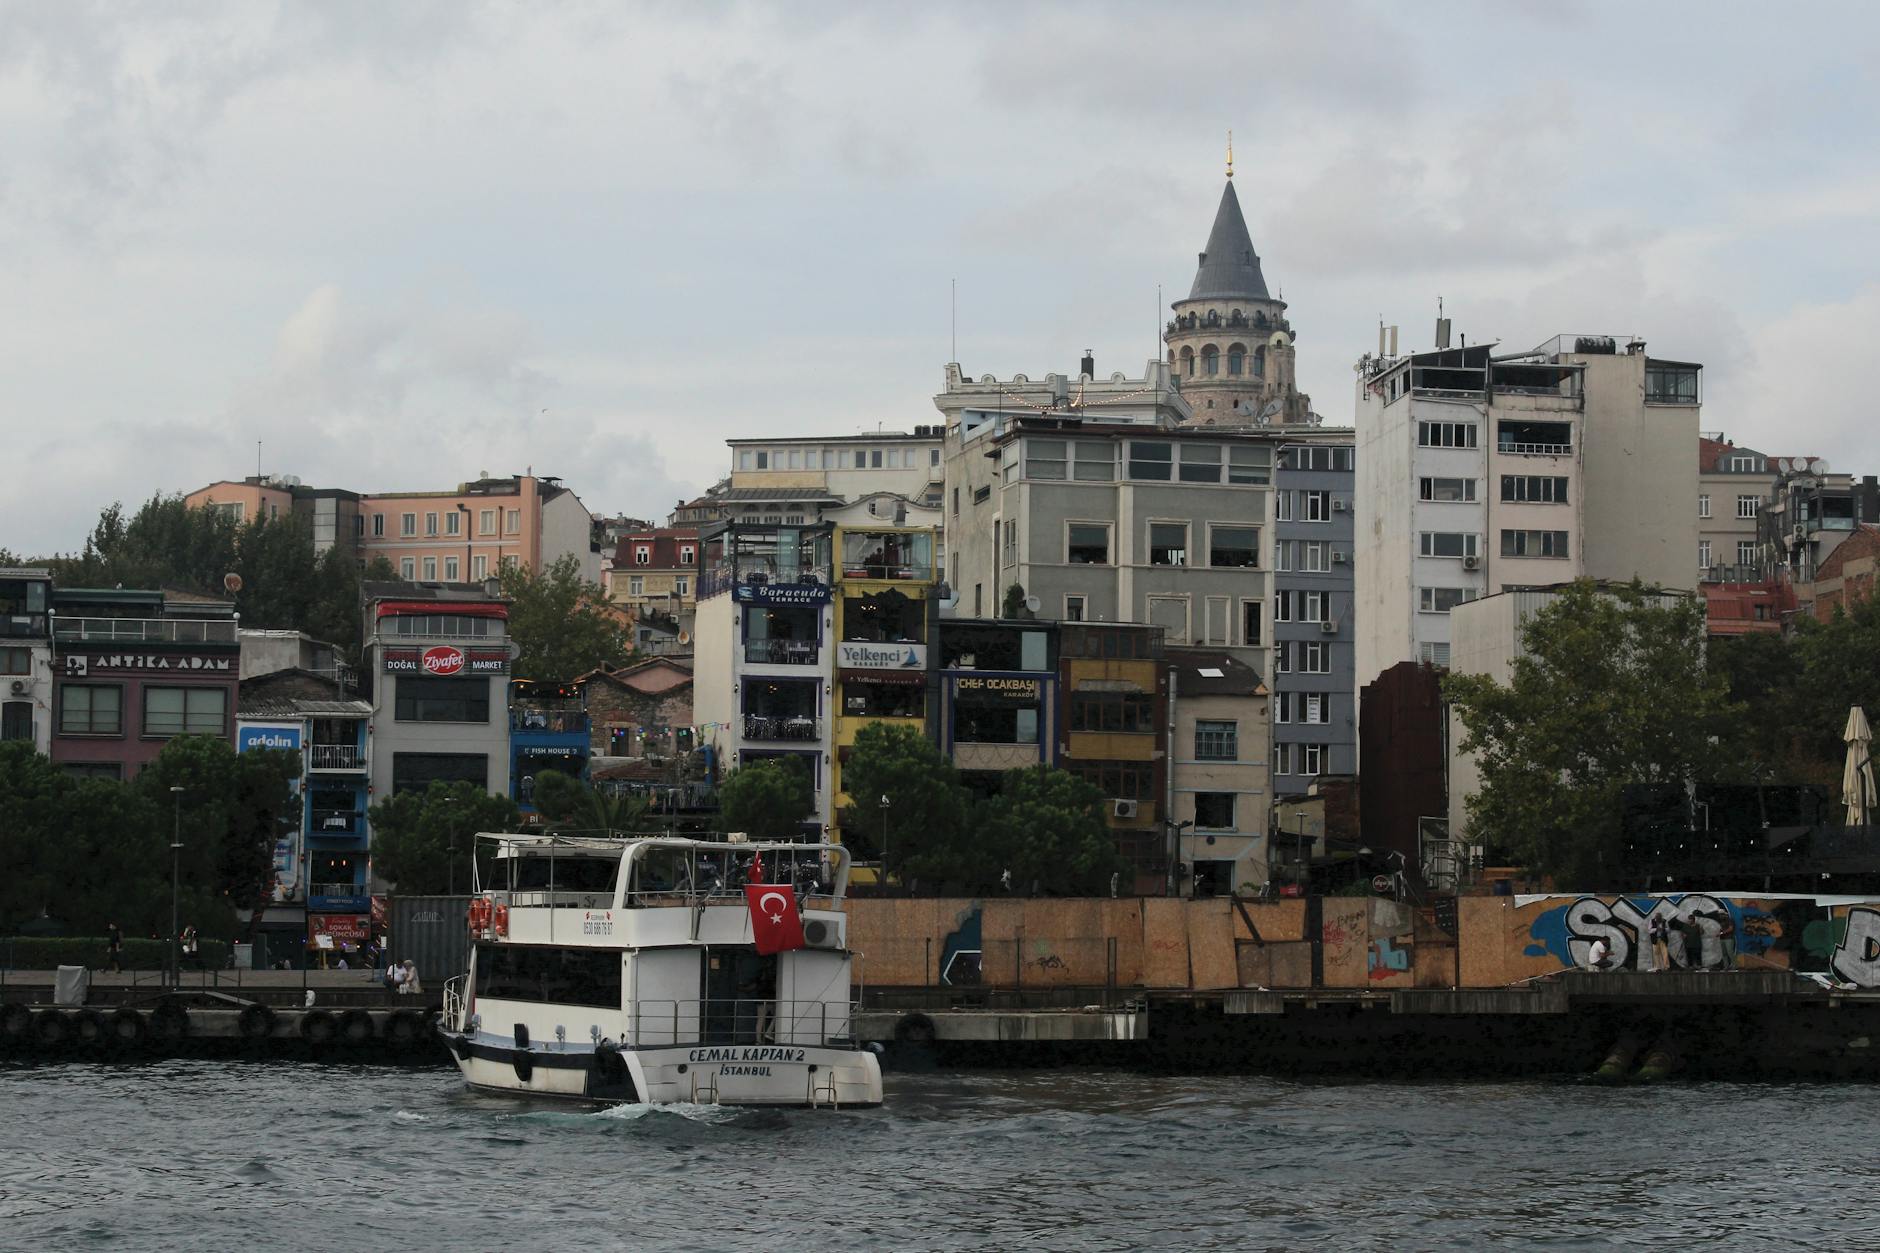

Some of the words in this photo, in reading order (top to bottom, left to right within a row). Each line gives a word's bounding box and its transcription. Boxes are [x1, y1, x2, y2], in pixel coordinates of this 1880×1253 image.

[758, 586, 825, 598] Baracuda
[843, 647, 901, 662] Yelkenci
[177, 656, 229, 670] ADAM
[387, 659, 417, 669] DOĞAL
[424, 653, 463, 671] Ziyafet
[472, 661, 503, 669] MARKET
[959, 678, 985, 689] CHEF
[986, 679, 1035, 693] OCAKBAŞI
[689, 1049, 738, 1061] CEMAL
[742, 1048, 794, 1061] KAPTAN
[795, 1049, 805, 1061] 2
[719, 1064, 772, 1076] İSTANBUL
